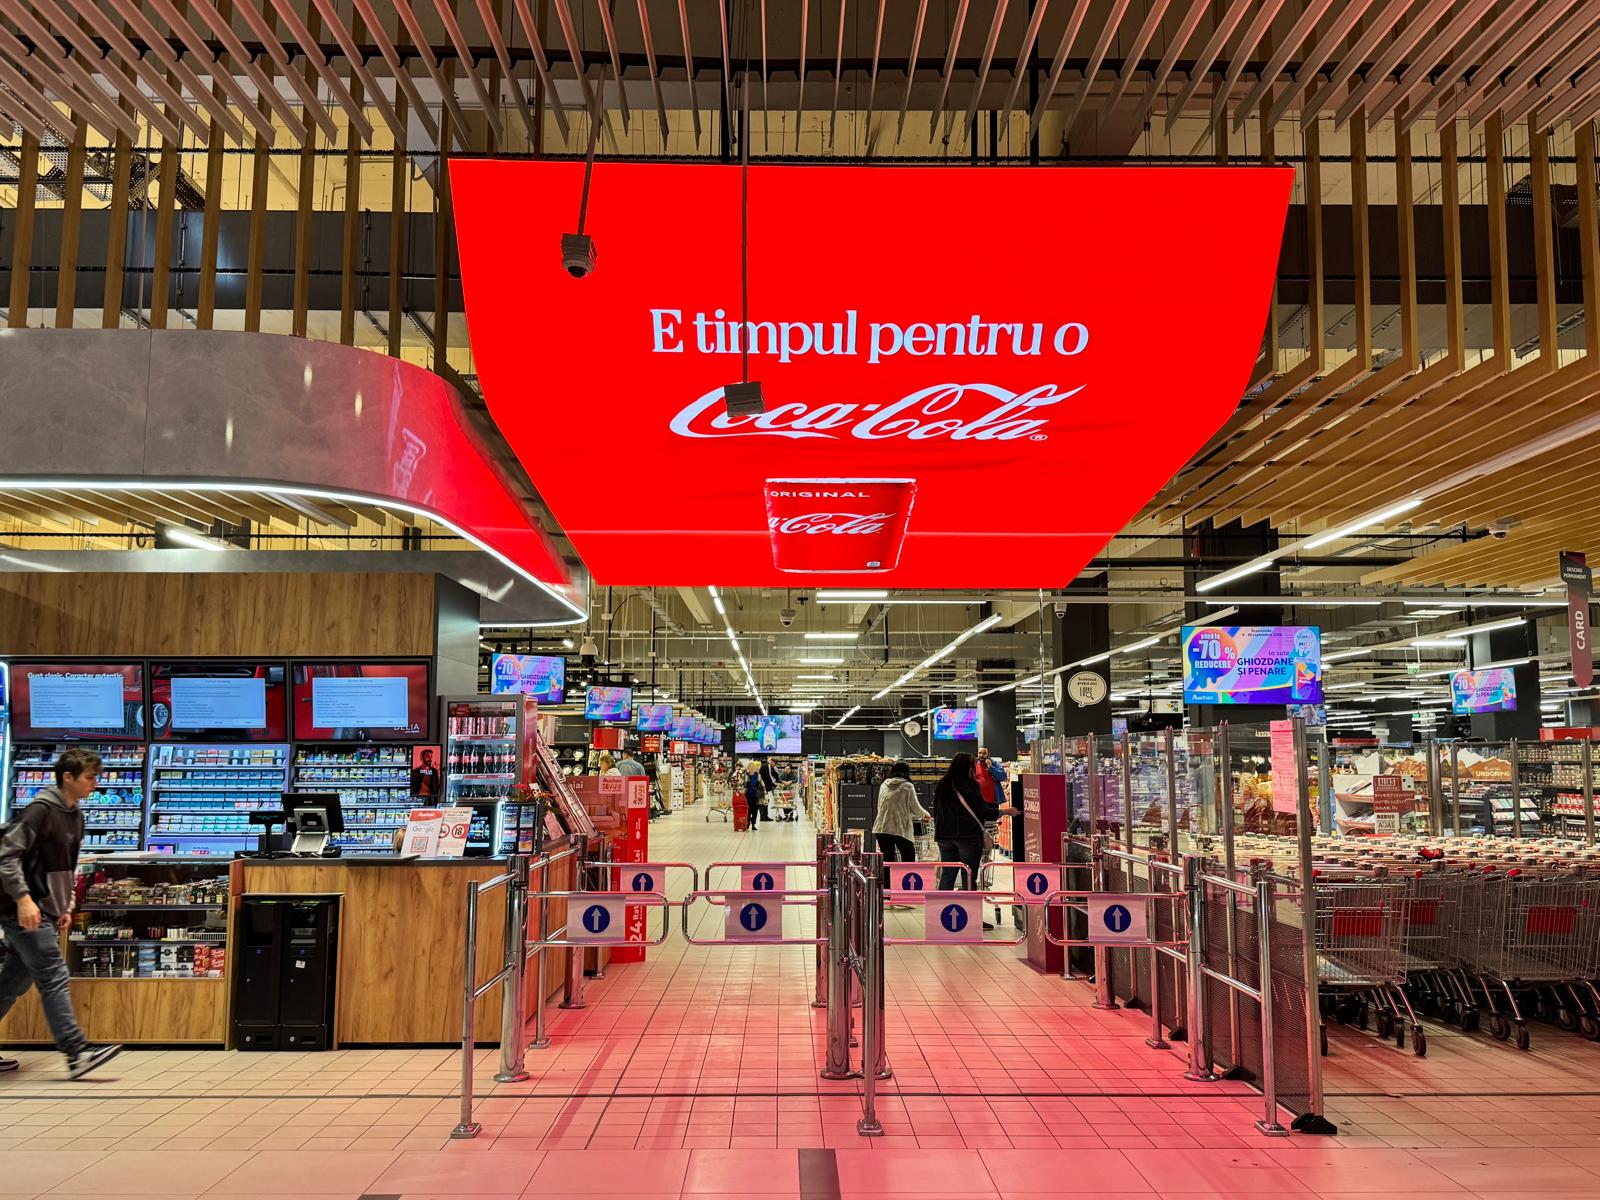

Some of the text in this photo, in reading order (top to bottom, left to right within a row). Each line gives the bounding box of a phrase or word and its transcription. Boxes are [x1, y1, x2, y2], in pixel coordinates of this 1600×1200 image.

[650, 308, 1089, 364] E timpul pentru o
[669, 382, 1087, 441] Coca-Cola
[1574, 610, 1586, 650] CARD
[1193, 639, 1220, 660] -70
[1195, 660, 1232, 669] REDUCERE
[1237, 657, 1294, 666] GHIOZDANE
[1249, 667, 1286, 675] PENARE
[453, 825, 464, 835] 18
[630, 921, 643, 942] 24
